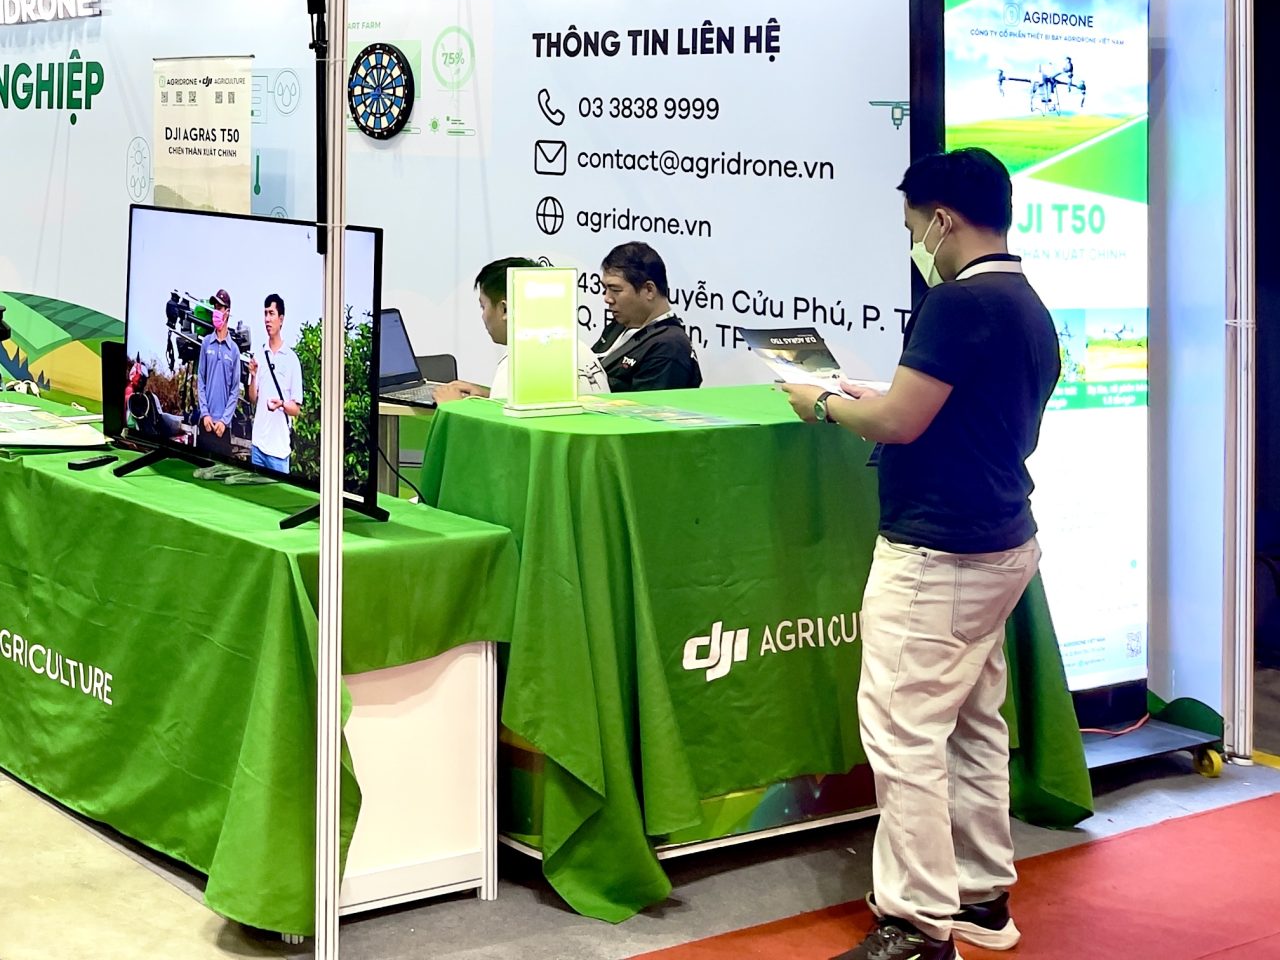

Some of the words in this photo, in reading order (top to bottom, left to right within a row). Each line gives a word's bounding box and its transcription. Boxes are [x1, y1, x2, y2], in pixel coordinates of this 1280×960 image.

[347, 21, 360, 30] ART
[1023, 11, 1094, 28] AGRIDRONE
[532, 24, 621, 58] THÔNG
[627, 28, 669, 57] TIN
[678, 19, 735, 56] LIÊN
[744, 17, 781, 63] HỆ
[441, 51, 465, 66] 75%
[578, 96, 604, 119] 03
[608, 97, 659, 120] 3838
[664, 98, 720, 121] 9999
[165, 126, 181, 141] DJI
[182, 127, 217, 142] AGRAS
[220, 128, 240, 143] T50
[577, 147, 835, 180] contact@agridrone.vn
[576, 206, 712, 238] agridrone.vn
[1017, 202, 1043, 235] JI
[1050, 203, 1106, 235] T50
[577, 304, 597, 332] Q.
[667, 280, 724, 312] uyễn
[732, 289, 784, 319] Cửu
[793, 296, 853, 332] Phú,
[862, 304, 885, 332] P.
[682, 620, 749, 683] dji
[759, 610, 863, 657] AGRICU
